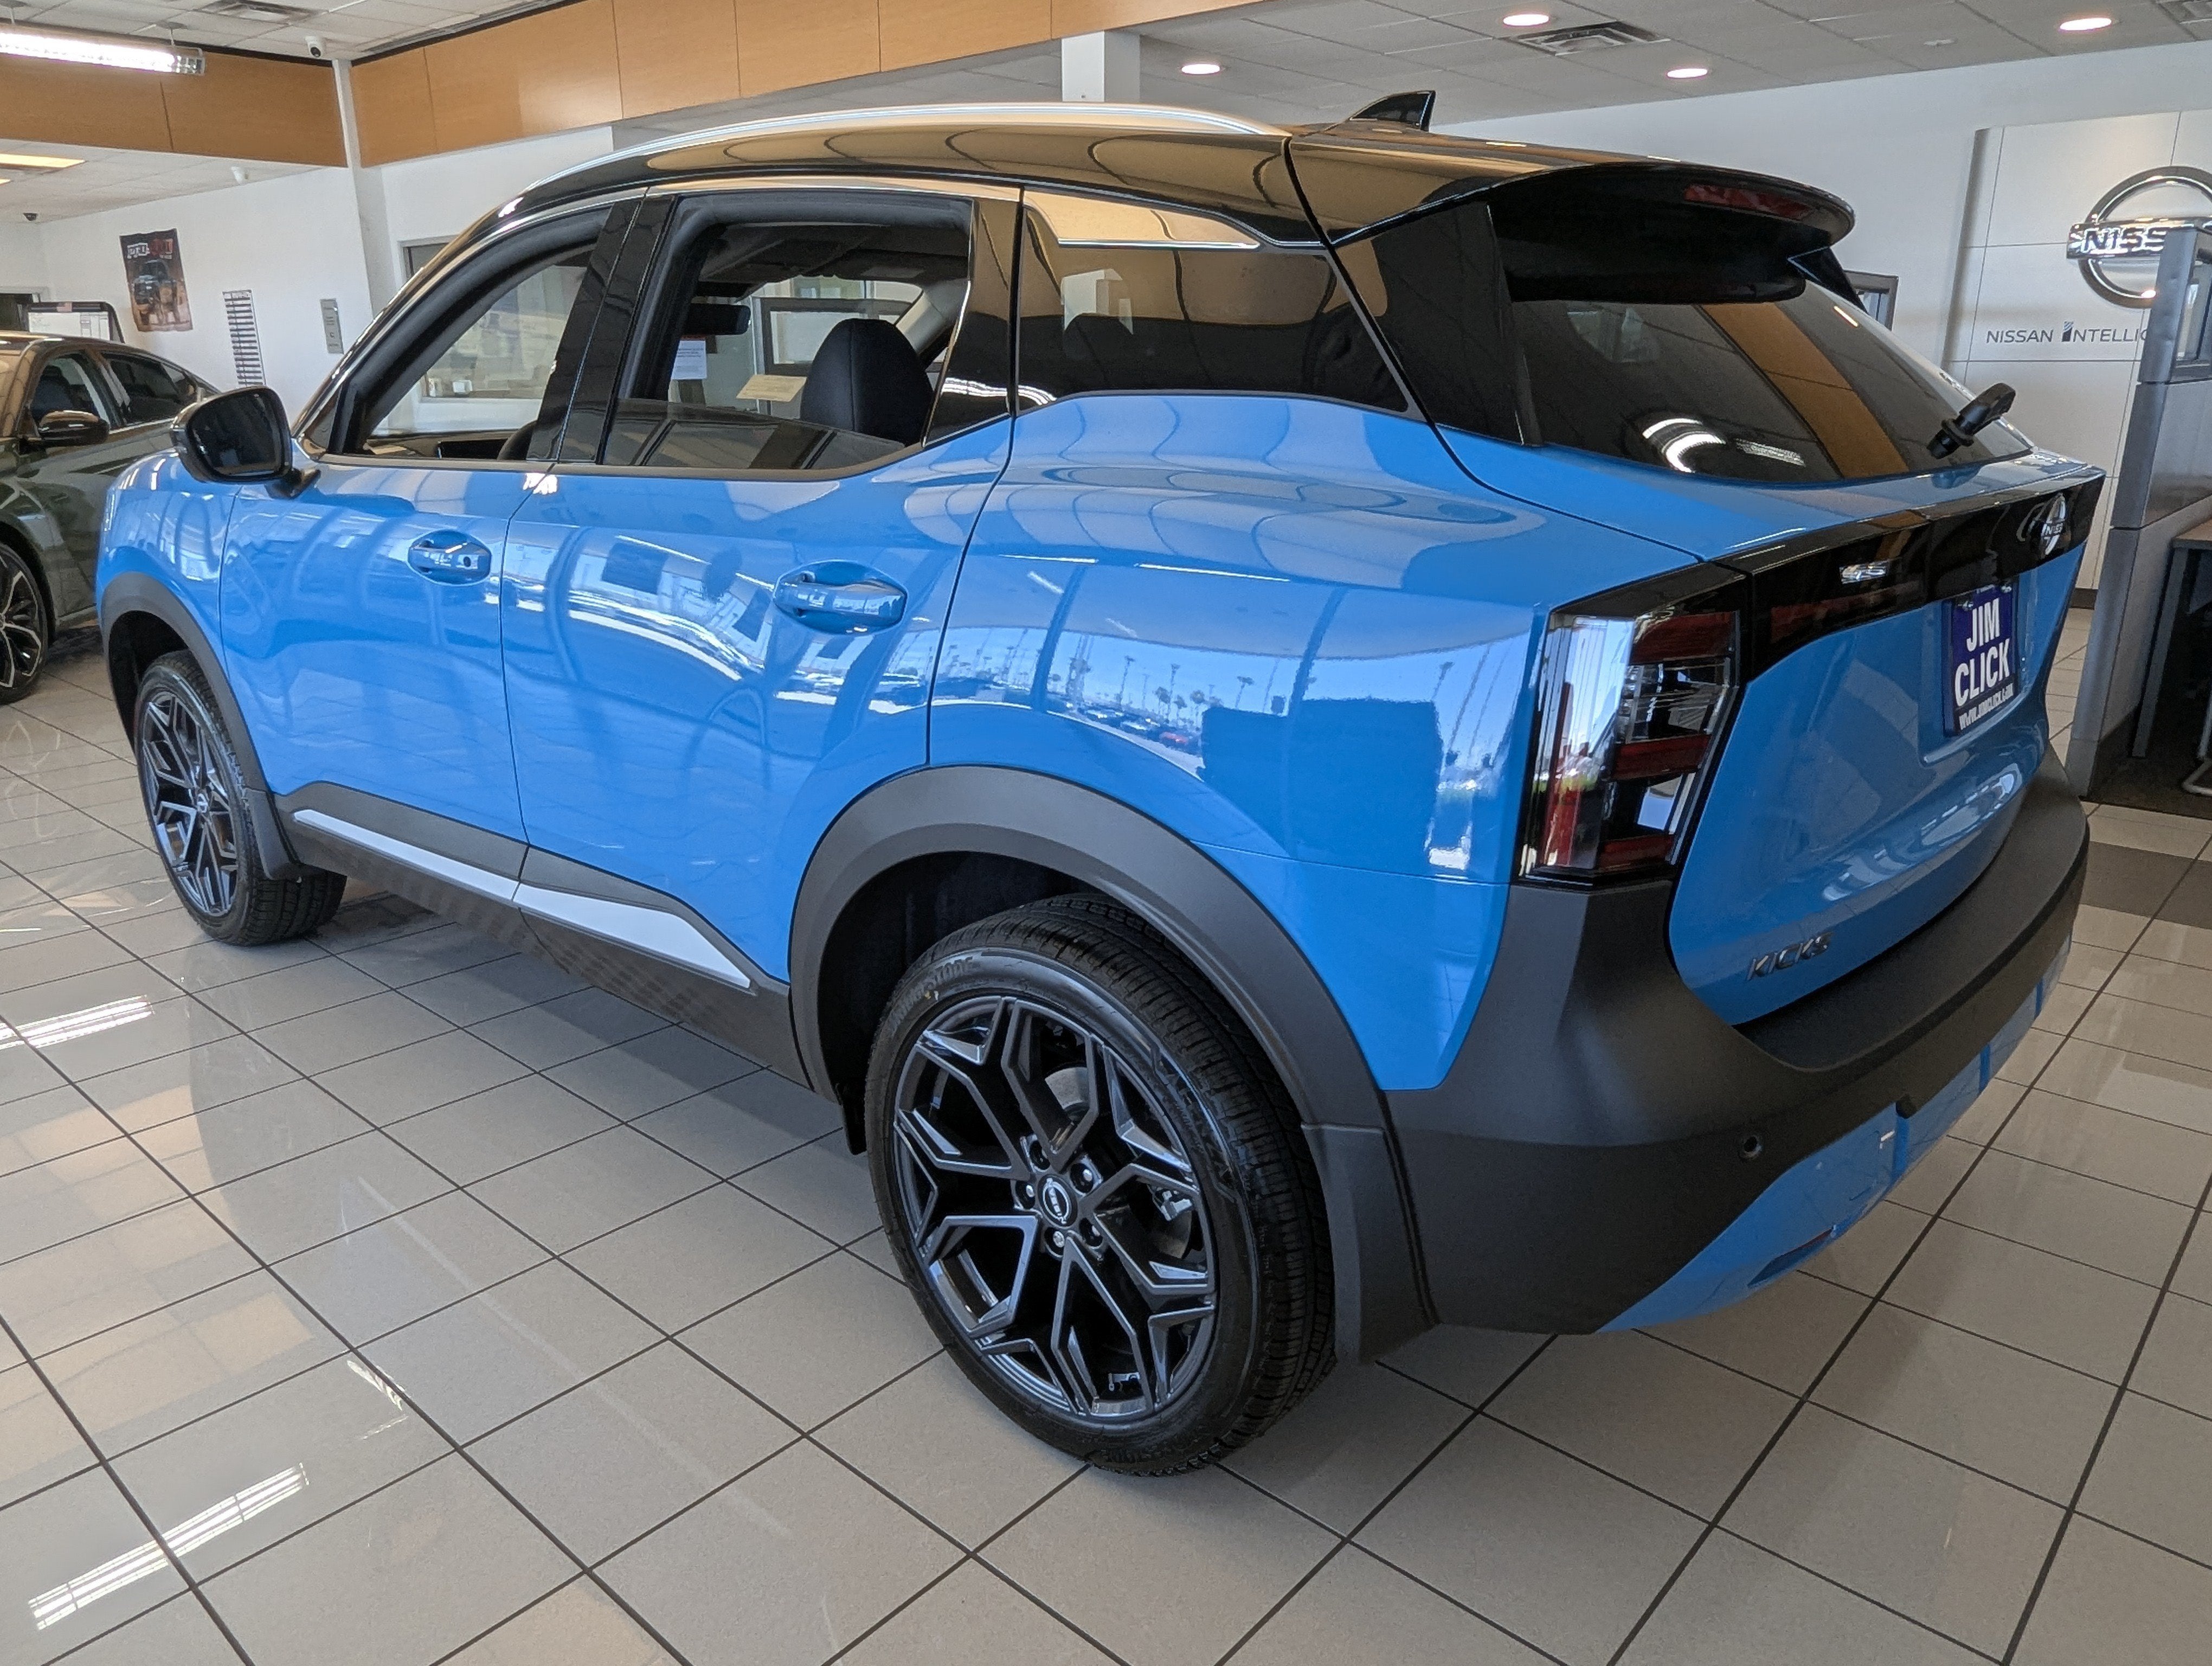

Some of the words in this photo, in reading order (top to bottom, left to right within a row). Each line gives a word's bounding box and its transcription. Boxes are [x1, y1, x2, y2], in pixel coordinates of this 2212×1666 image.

[1986, 329, 2054, 344] NISSAN
[1966, 598, 2000, 652] JIM
[1954, 638, 2010, 707] CLICK
[1045, 1177, 1068, 1225] NISSAN
